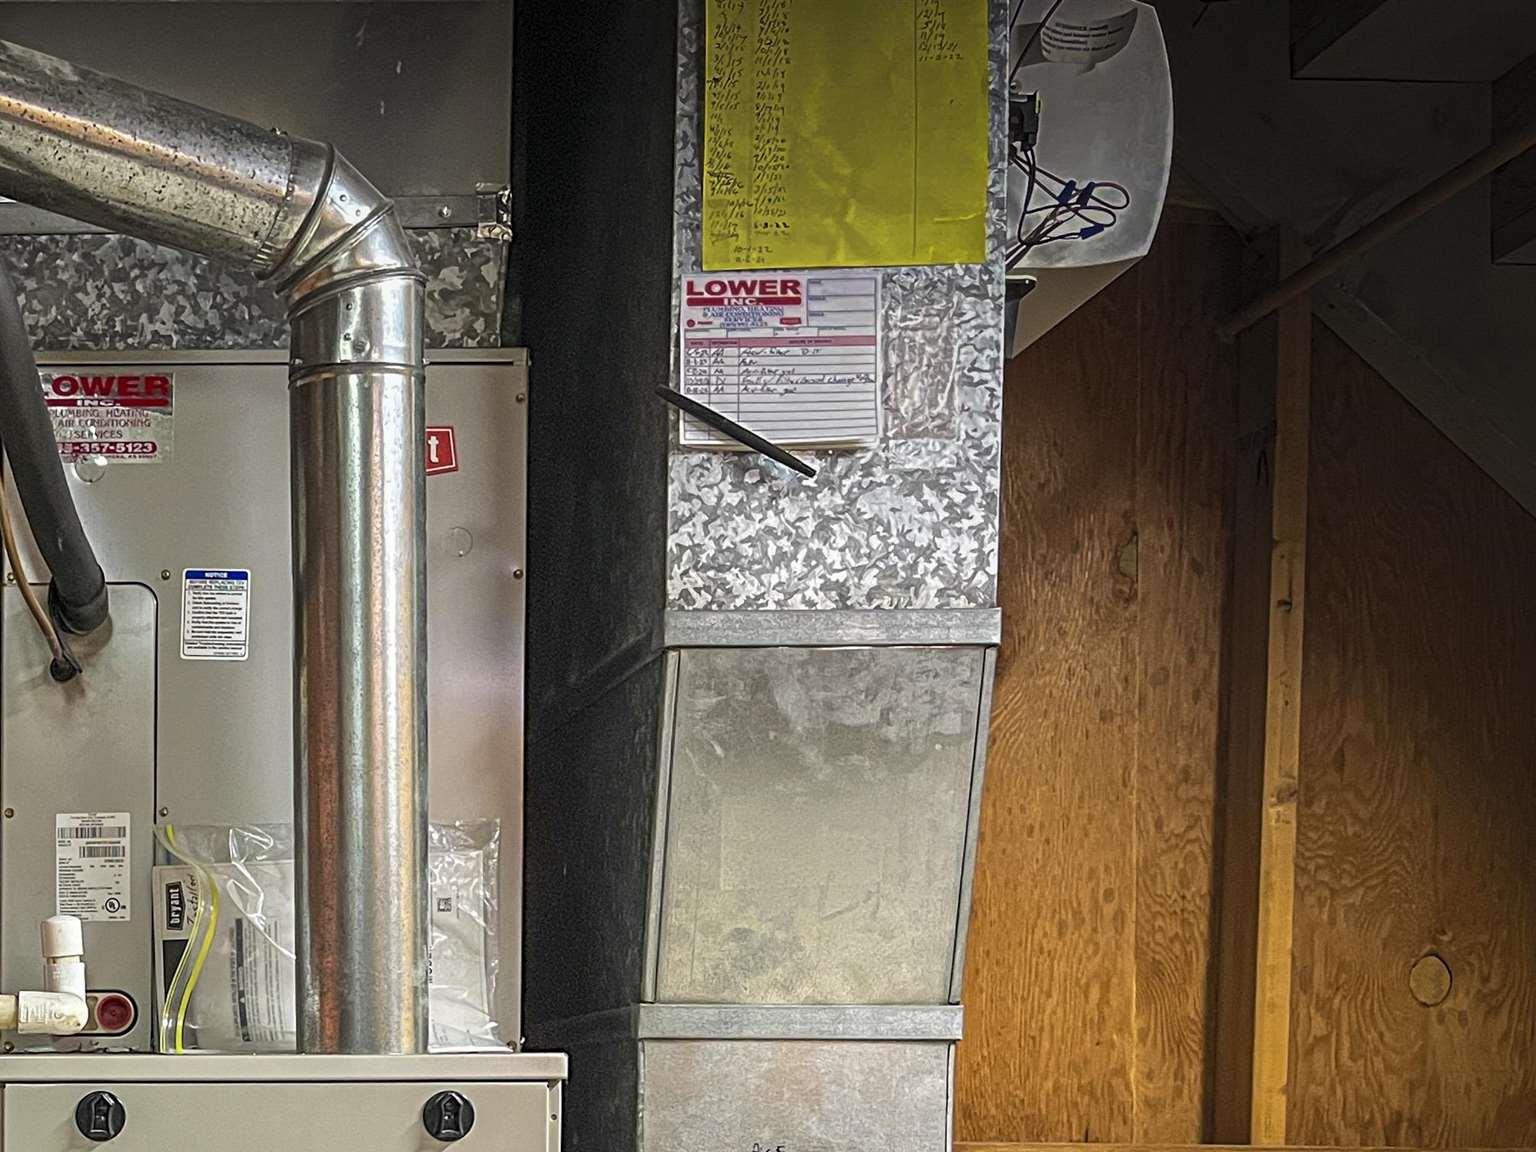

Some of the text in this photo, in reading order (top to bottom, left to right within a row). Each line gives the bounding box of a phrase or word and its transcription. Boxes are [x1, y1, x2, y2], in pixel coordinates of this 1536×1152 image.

[686, 279, 802, 296] LOWER
[723, 297, 763, 306] INC.
[45, 375, 170, 396] OWER
[76, 399, 121, 407] INC.
[58, 442, 153, 453] 5-357-5123
[170, 888, 182, 925] bryant
